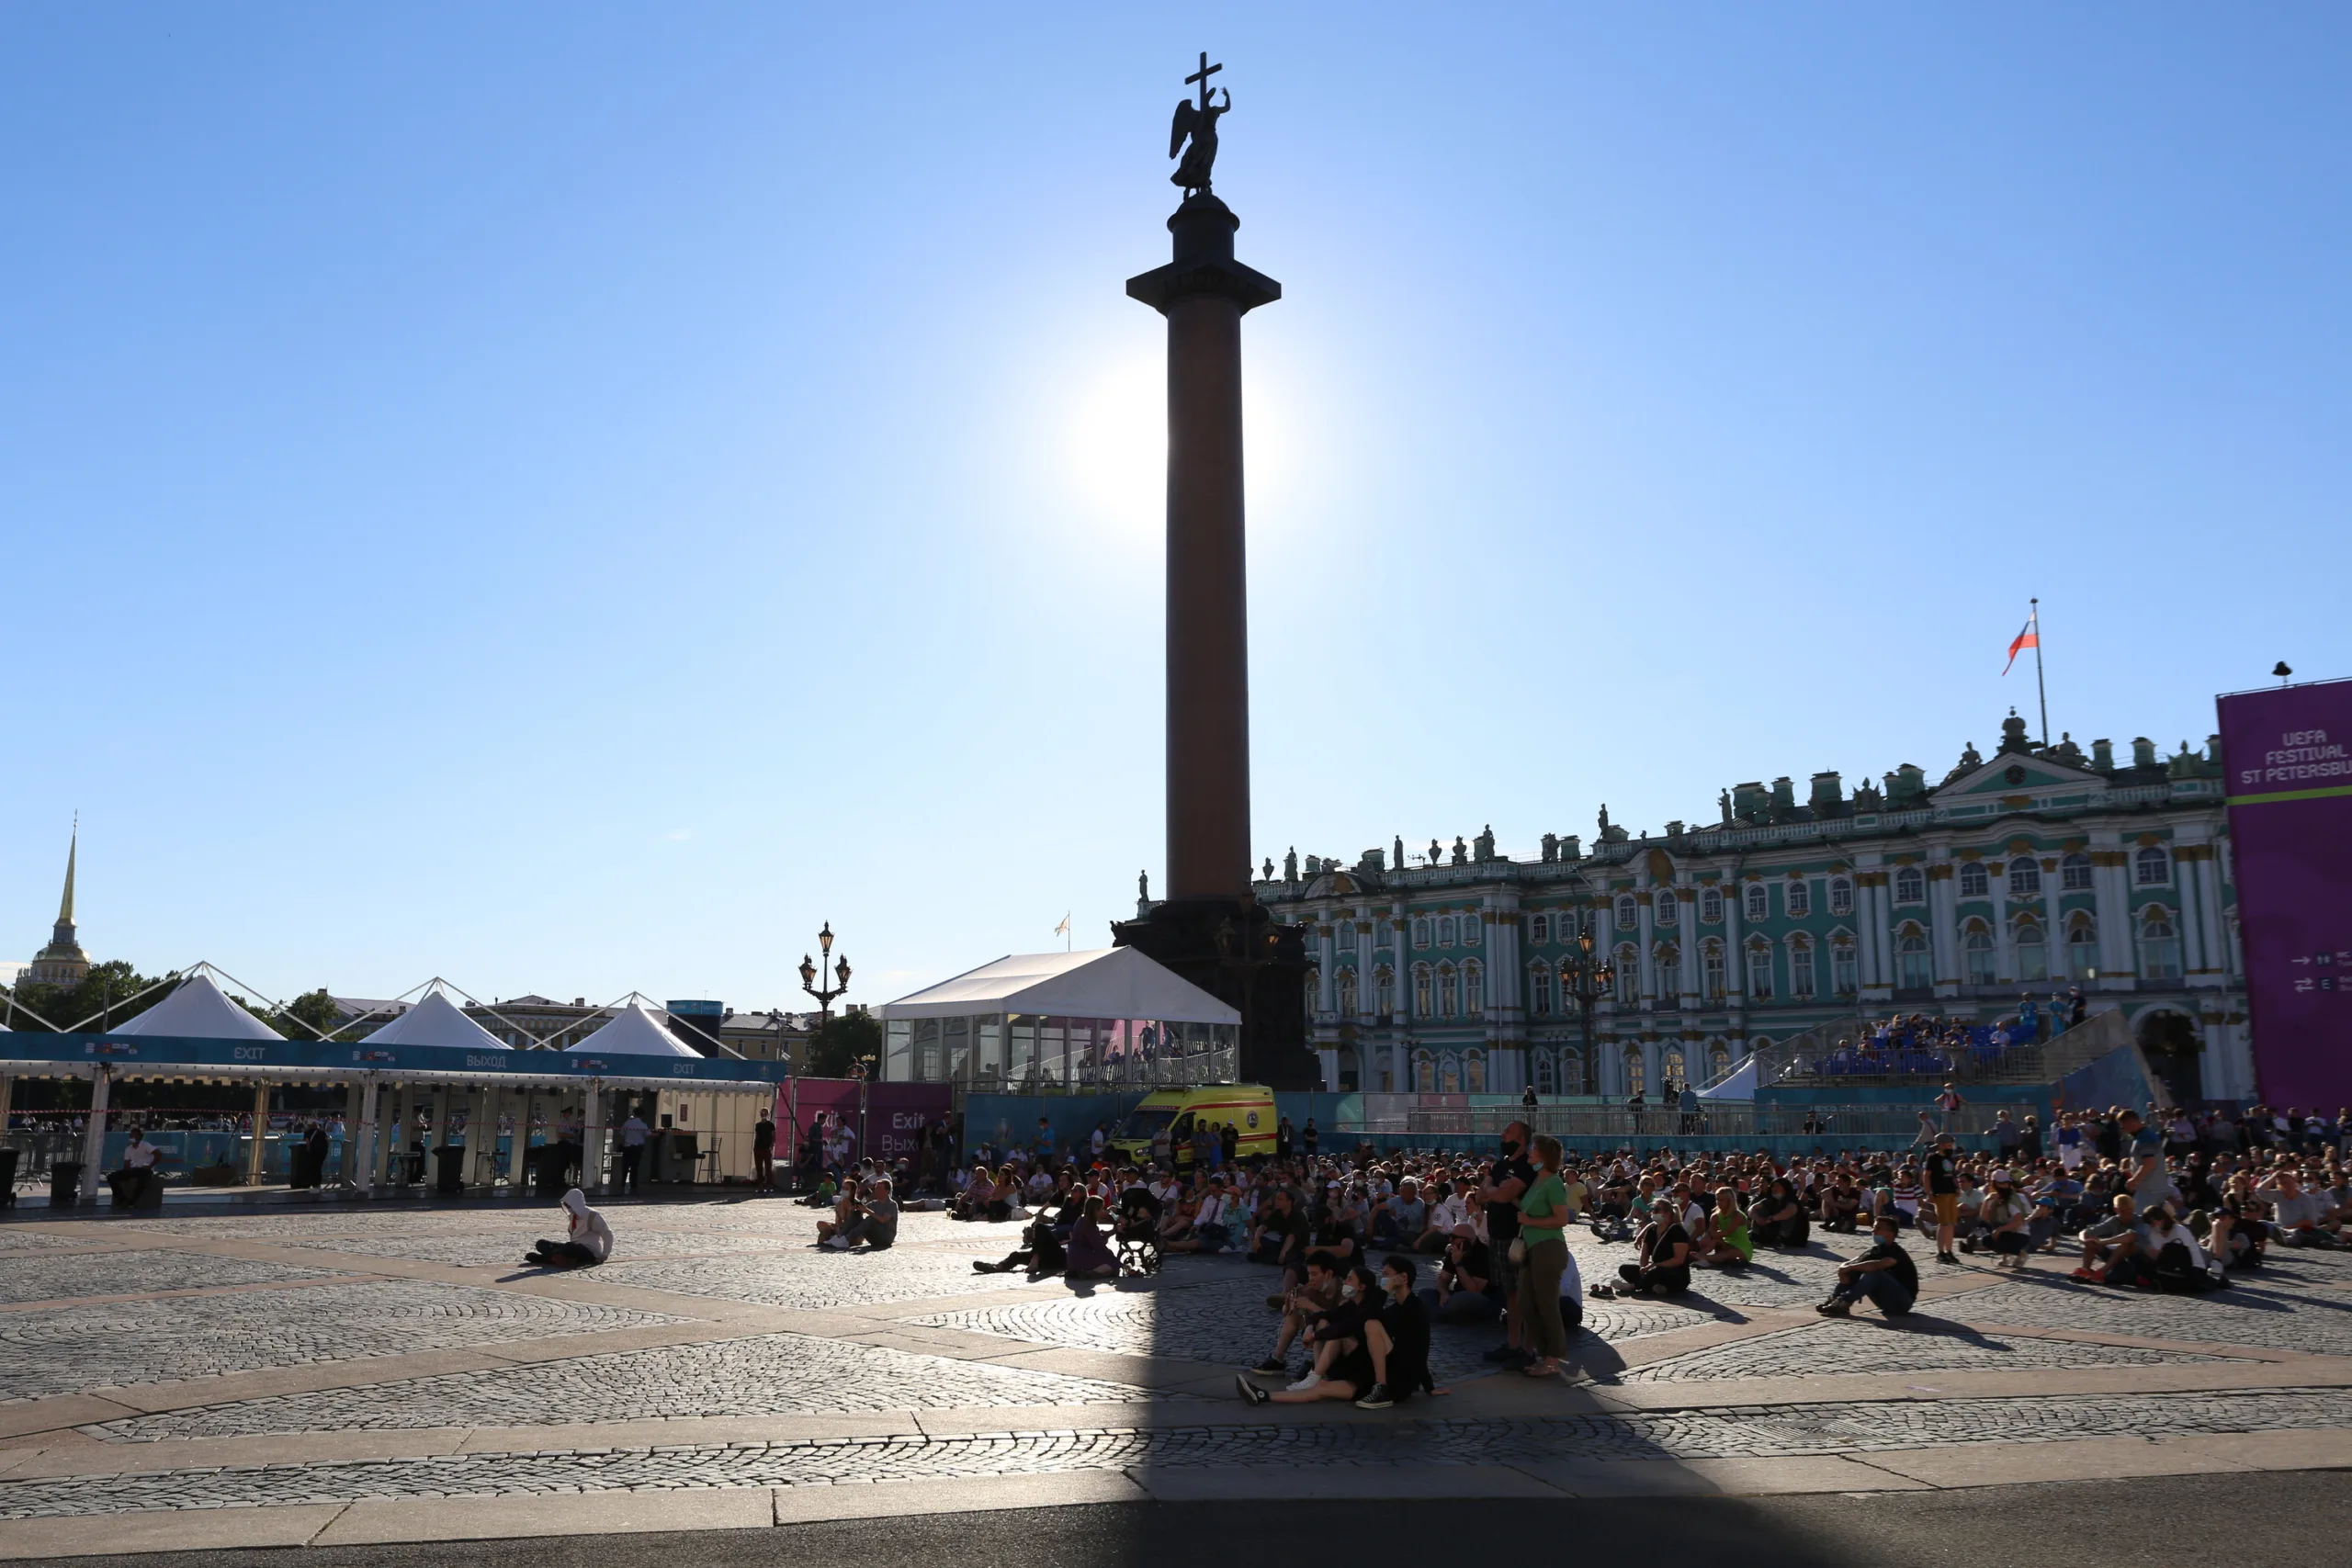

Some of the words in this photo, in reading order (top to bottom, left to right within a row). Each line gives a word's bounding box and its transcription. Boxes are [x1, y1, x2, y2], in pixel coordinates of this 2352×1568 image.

[2282, 729, 2327, 746] UEFA
[2241, 770, 2262, 784] ST
[234, 1047, 266, 1060] EXIT
[467, 1055, 506, 1069] ВЫХОД
[673, 1063, 695, 1075] EXIT
[893, 1112, 925, 1129] Exit
[882, 1134, 920, 1151] Вых
